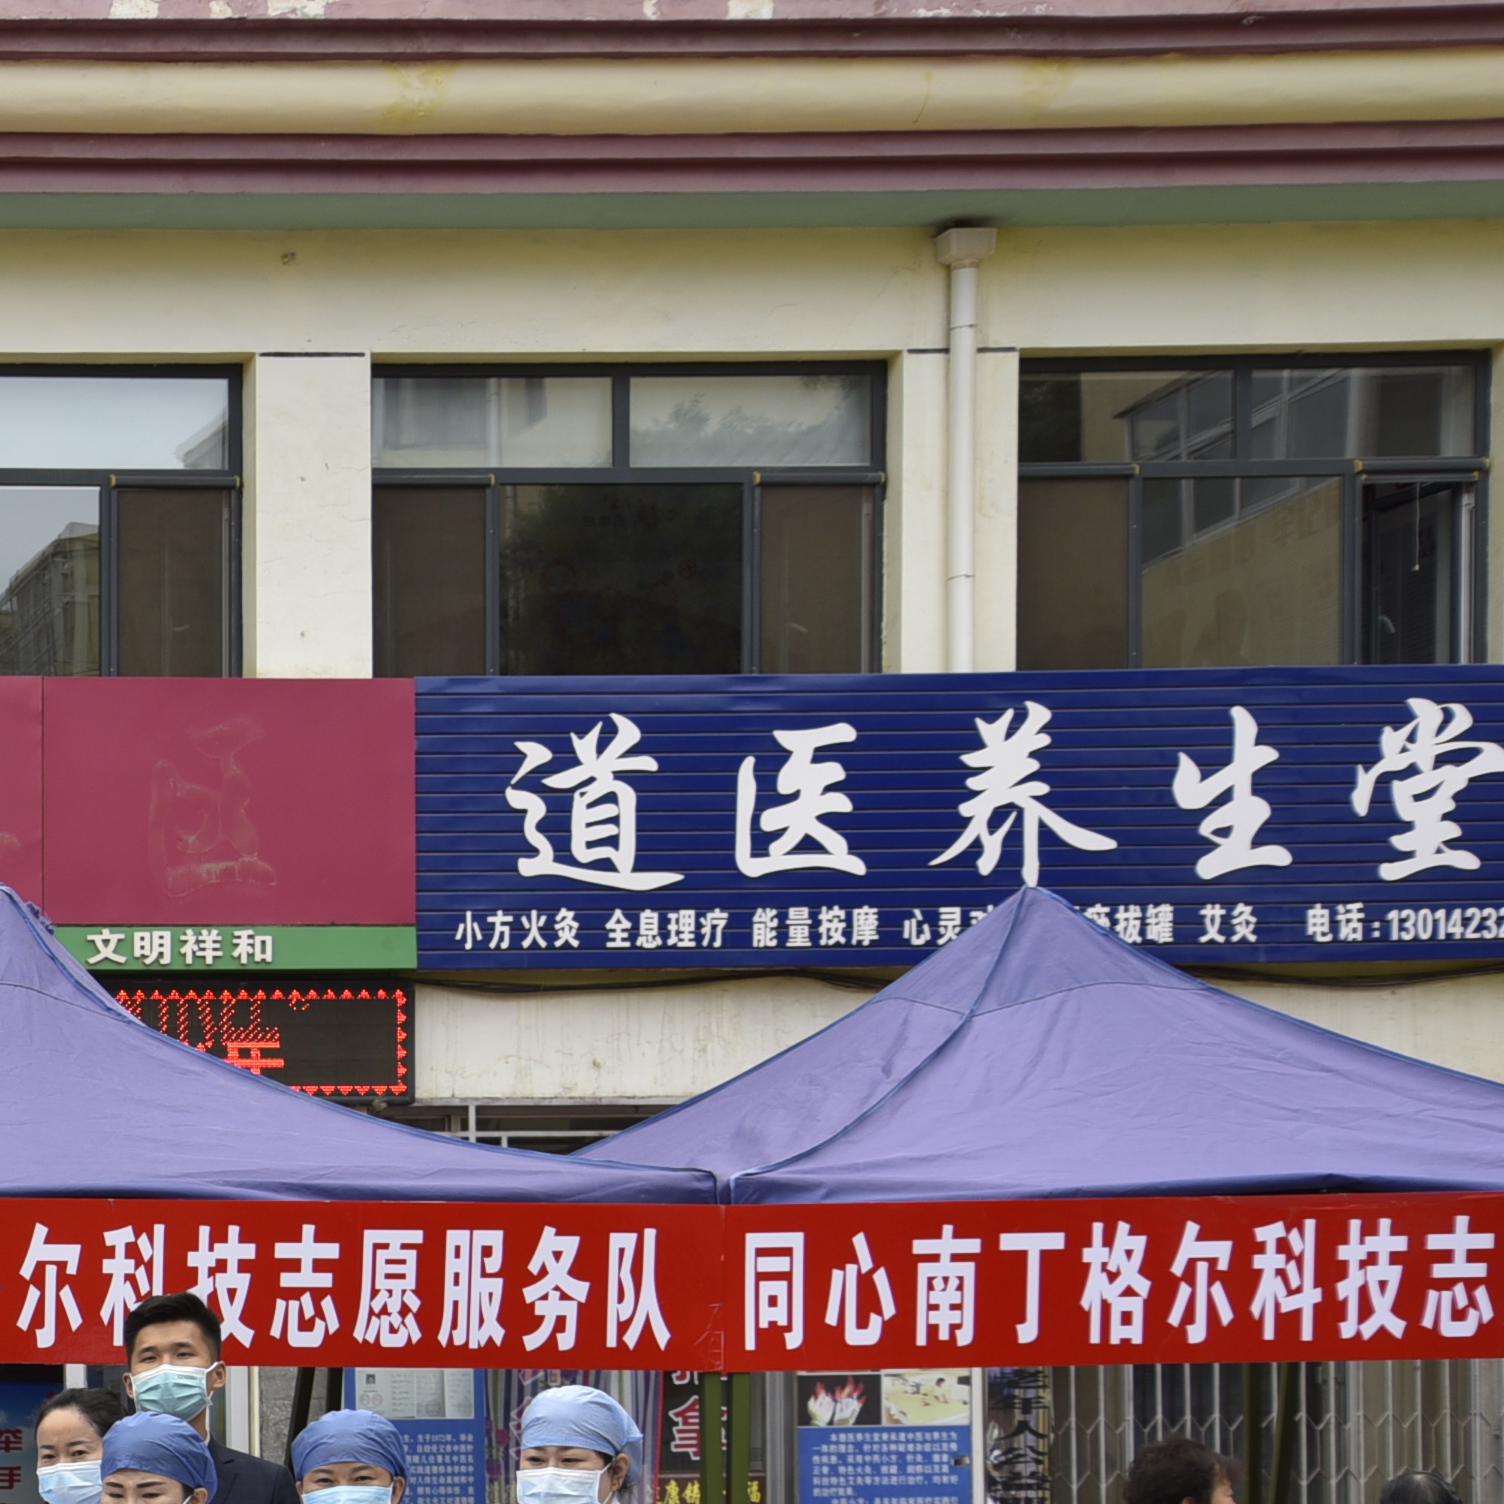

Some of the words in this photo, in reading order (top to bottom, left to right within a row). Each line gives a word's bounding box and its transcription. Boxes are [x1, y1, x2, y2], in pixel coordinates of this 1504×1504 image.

[505, 697, 1504, 891] 道医养生堂
[86, 927, 274, 965] 文明祥和
[455, 908, 580, 950] 小方火灸
[605, 908, 729, 949] 全息理疗
[752, 905, 880, 948] 能量按摩
[1198, 902, 1258, 943] 艾灸
[744, 1215, 1496, 1352] 同心南丁格尔科技志
